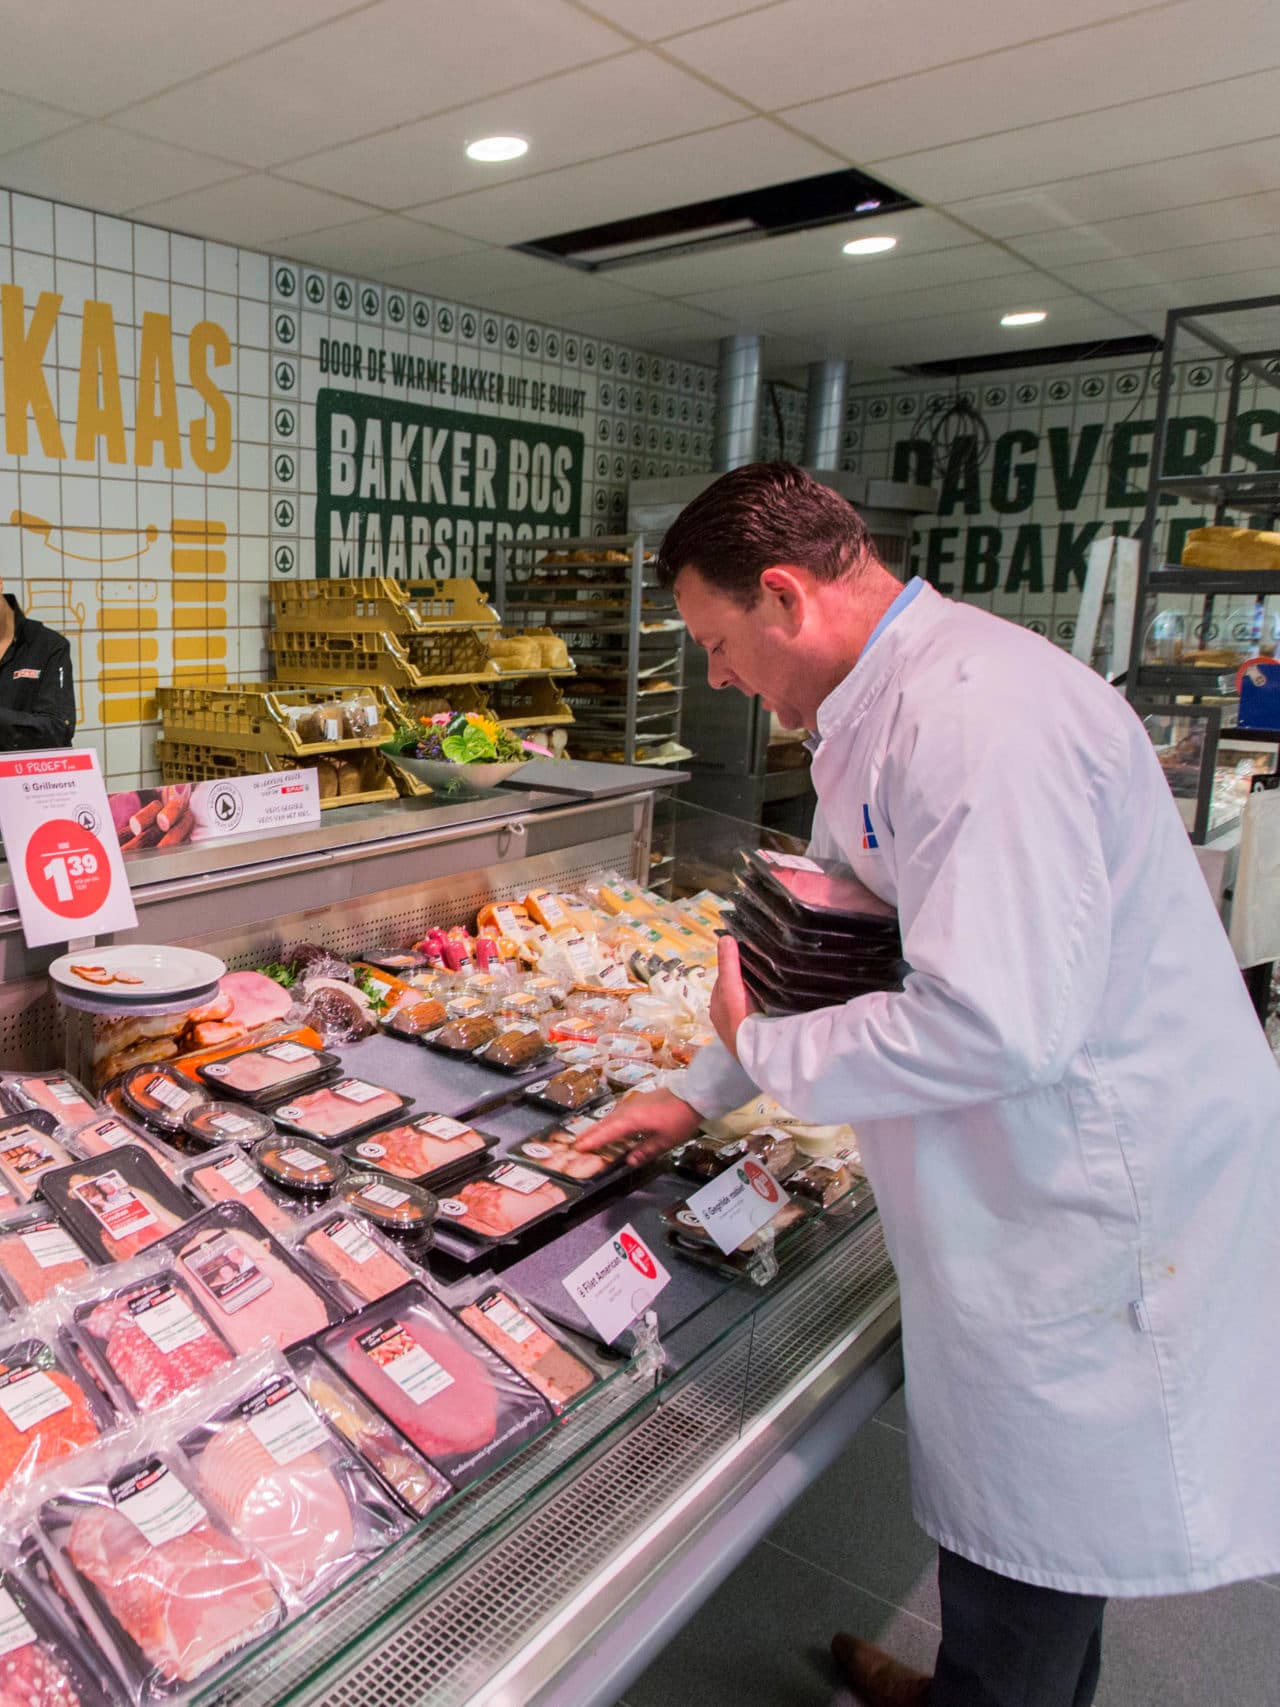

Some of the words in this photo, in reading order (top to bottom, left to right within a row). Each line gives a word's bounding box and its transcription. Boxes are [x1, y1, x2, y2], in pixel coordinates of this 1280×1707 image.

[0, 283, 233, 475] KAAS
[320, 338, 363, 380] DOOR
[368, 347, 387, 385] DE
[391, 352, 447, 394] WARME
[451, 365, 505, 405] BAKKER
[507, 375, 529, 409] UIT
[531, 380, 547, 413] DE
[549, 384, 587, 418] BUURT
[330, 412, 498, 510] BAKKER
[508, 438, 574, 516] BOS
[14, 762, 23, 774] U
[32, 781, 76, 791] Grillworst
[582, 1277, 598, 1293] Filet
[595, 1256, 622, 1281] American
